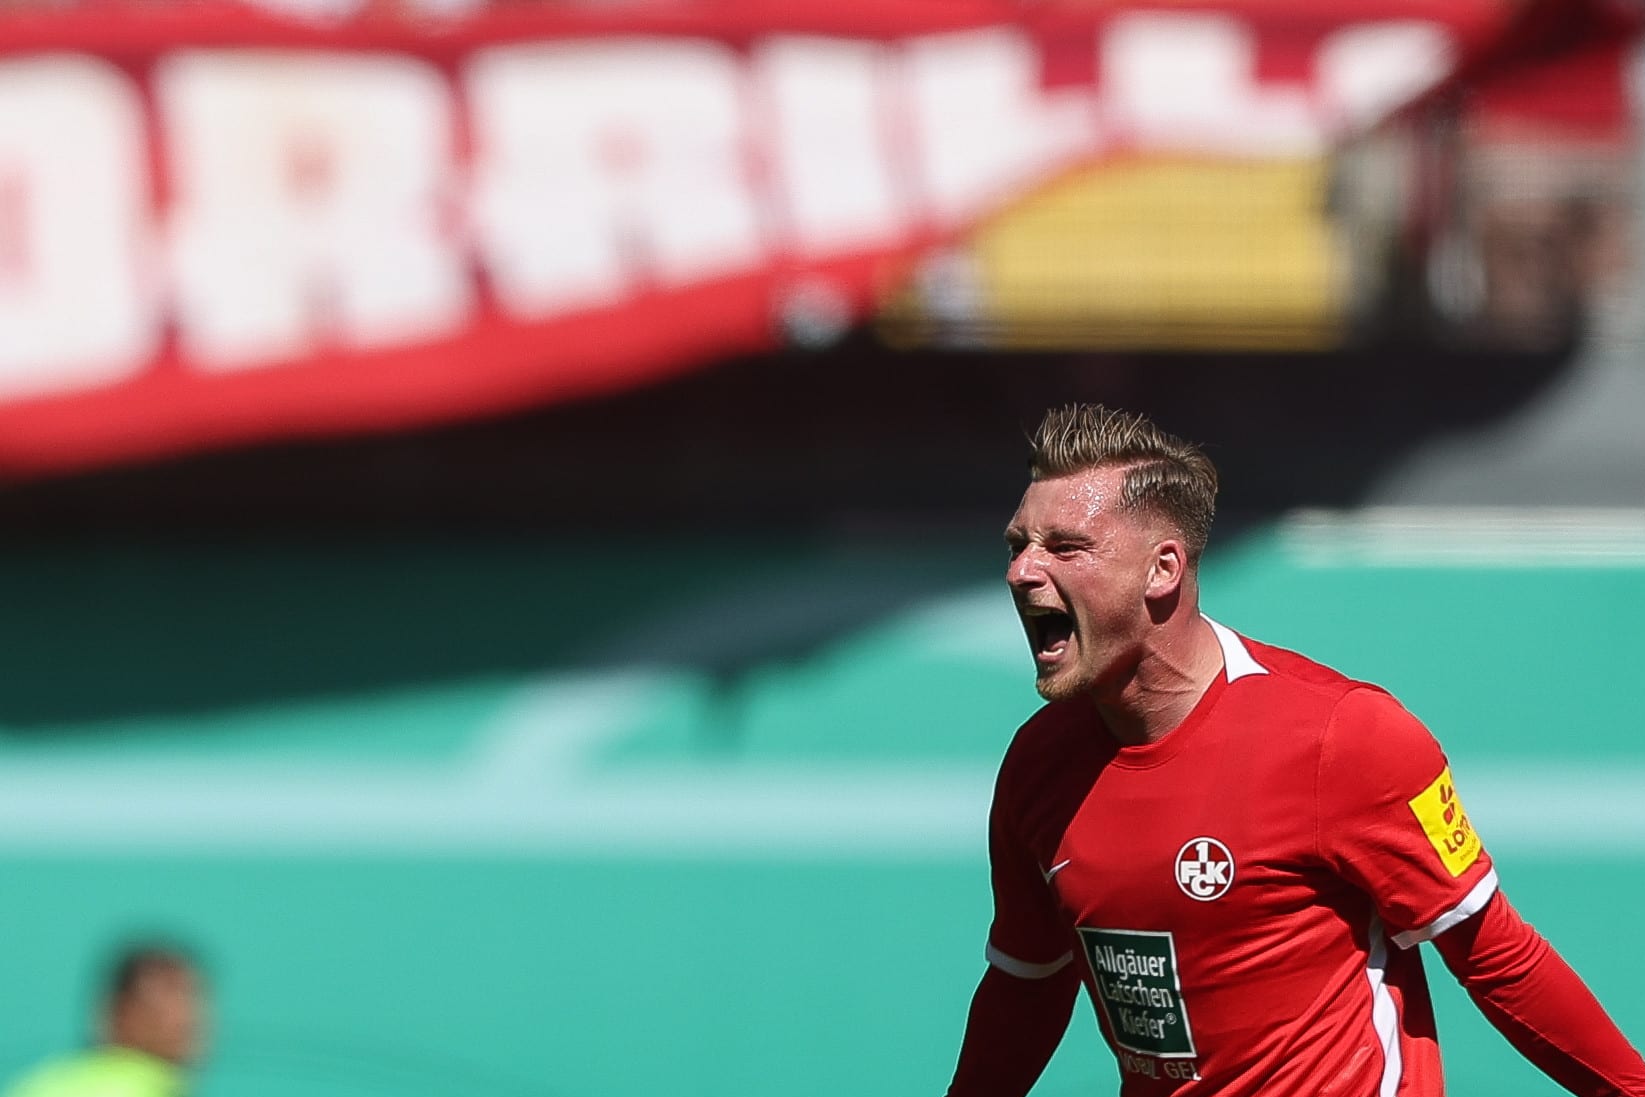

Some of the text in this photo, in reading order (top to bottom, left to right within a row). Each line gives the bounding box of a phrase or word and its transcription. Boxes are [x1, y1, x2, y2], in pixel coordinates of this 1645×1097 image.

[1095, 945, 1166, 980] Allgäuer
[1100, 973, 1174, 1008] Latschen
[1163, 1061, 1203, 1082] GEL
